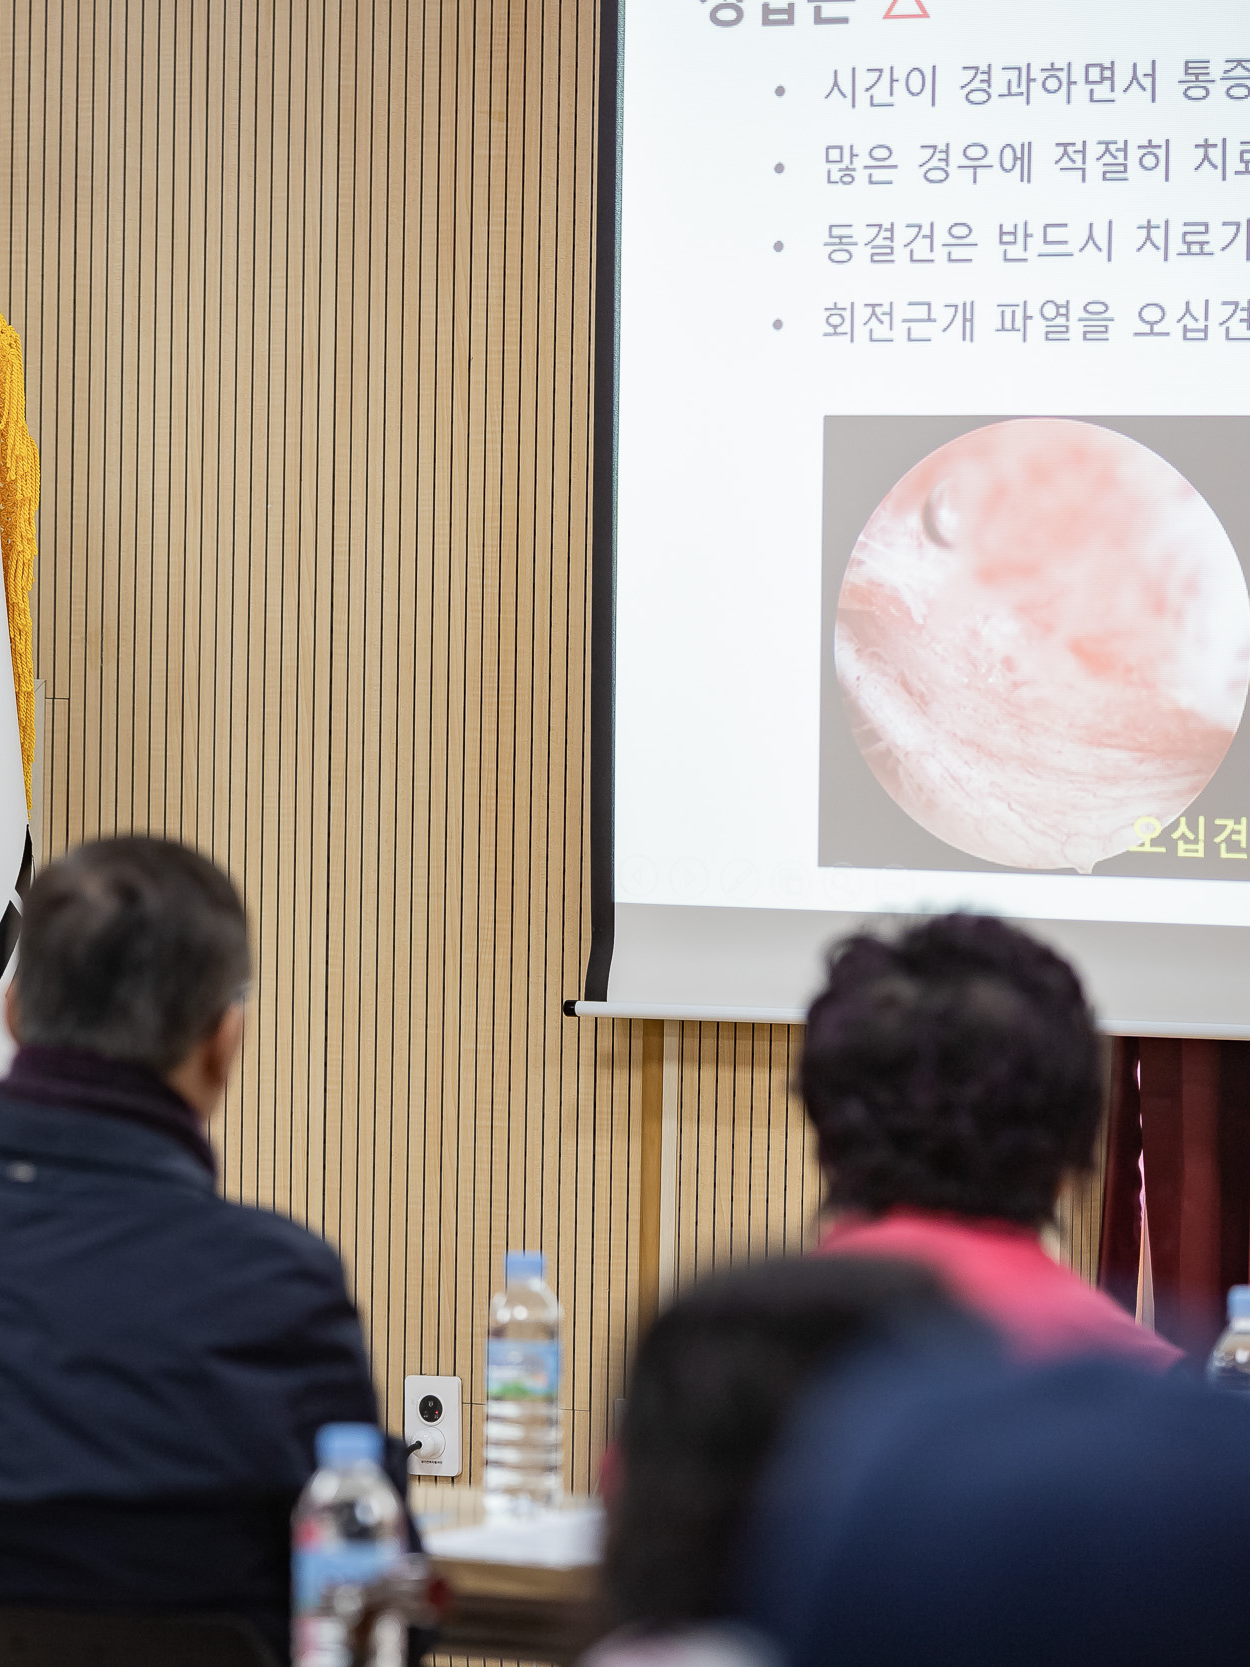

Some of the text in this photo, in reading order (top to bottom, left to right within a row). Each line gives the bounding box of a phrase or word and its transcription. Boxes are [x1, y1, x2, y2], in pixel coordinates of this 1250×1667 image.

[825, 58, 1250, 109] 시간이 경과하면서 통증
[826, 145, 898, 185] 많은
[919, 142, 1032, 184] 경우에
[1055, 139, 1169, 183] 적절히
[824, 222, 978, 263] 동결건은
[999, 219, 1112, 262] 반드시
[823, 299, 1250, 343] 회전근개 파열을 오십견
[1127, 815, 1248, 859] 오십견
